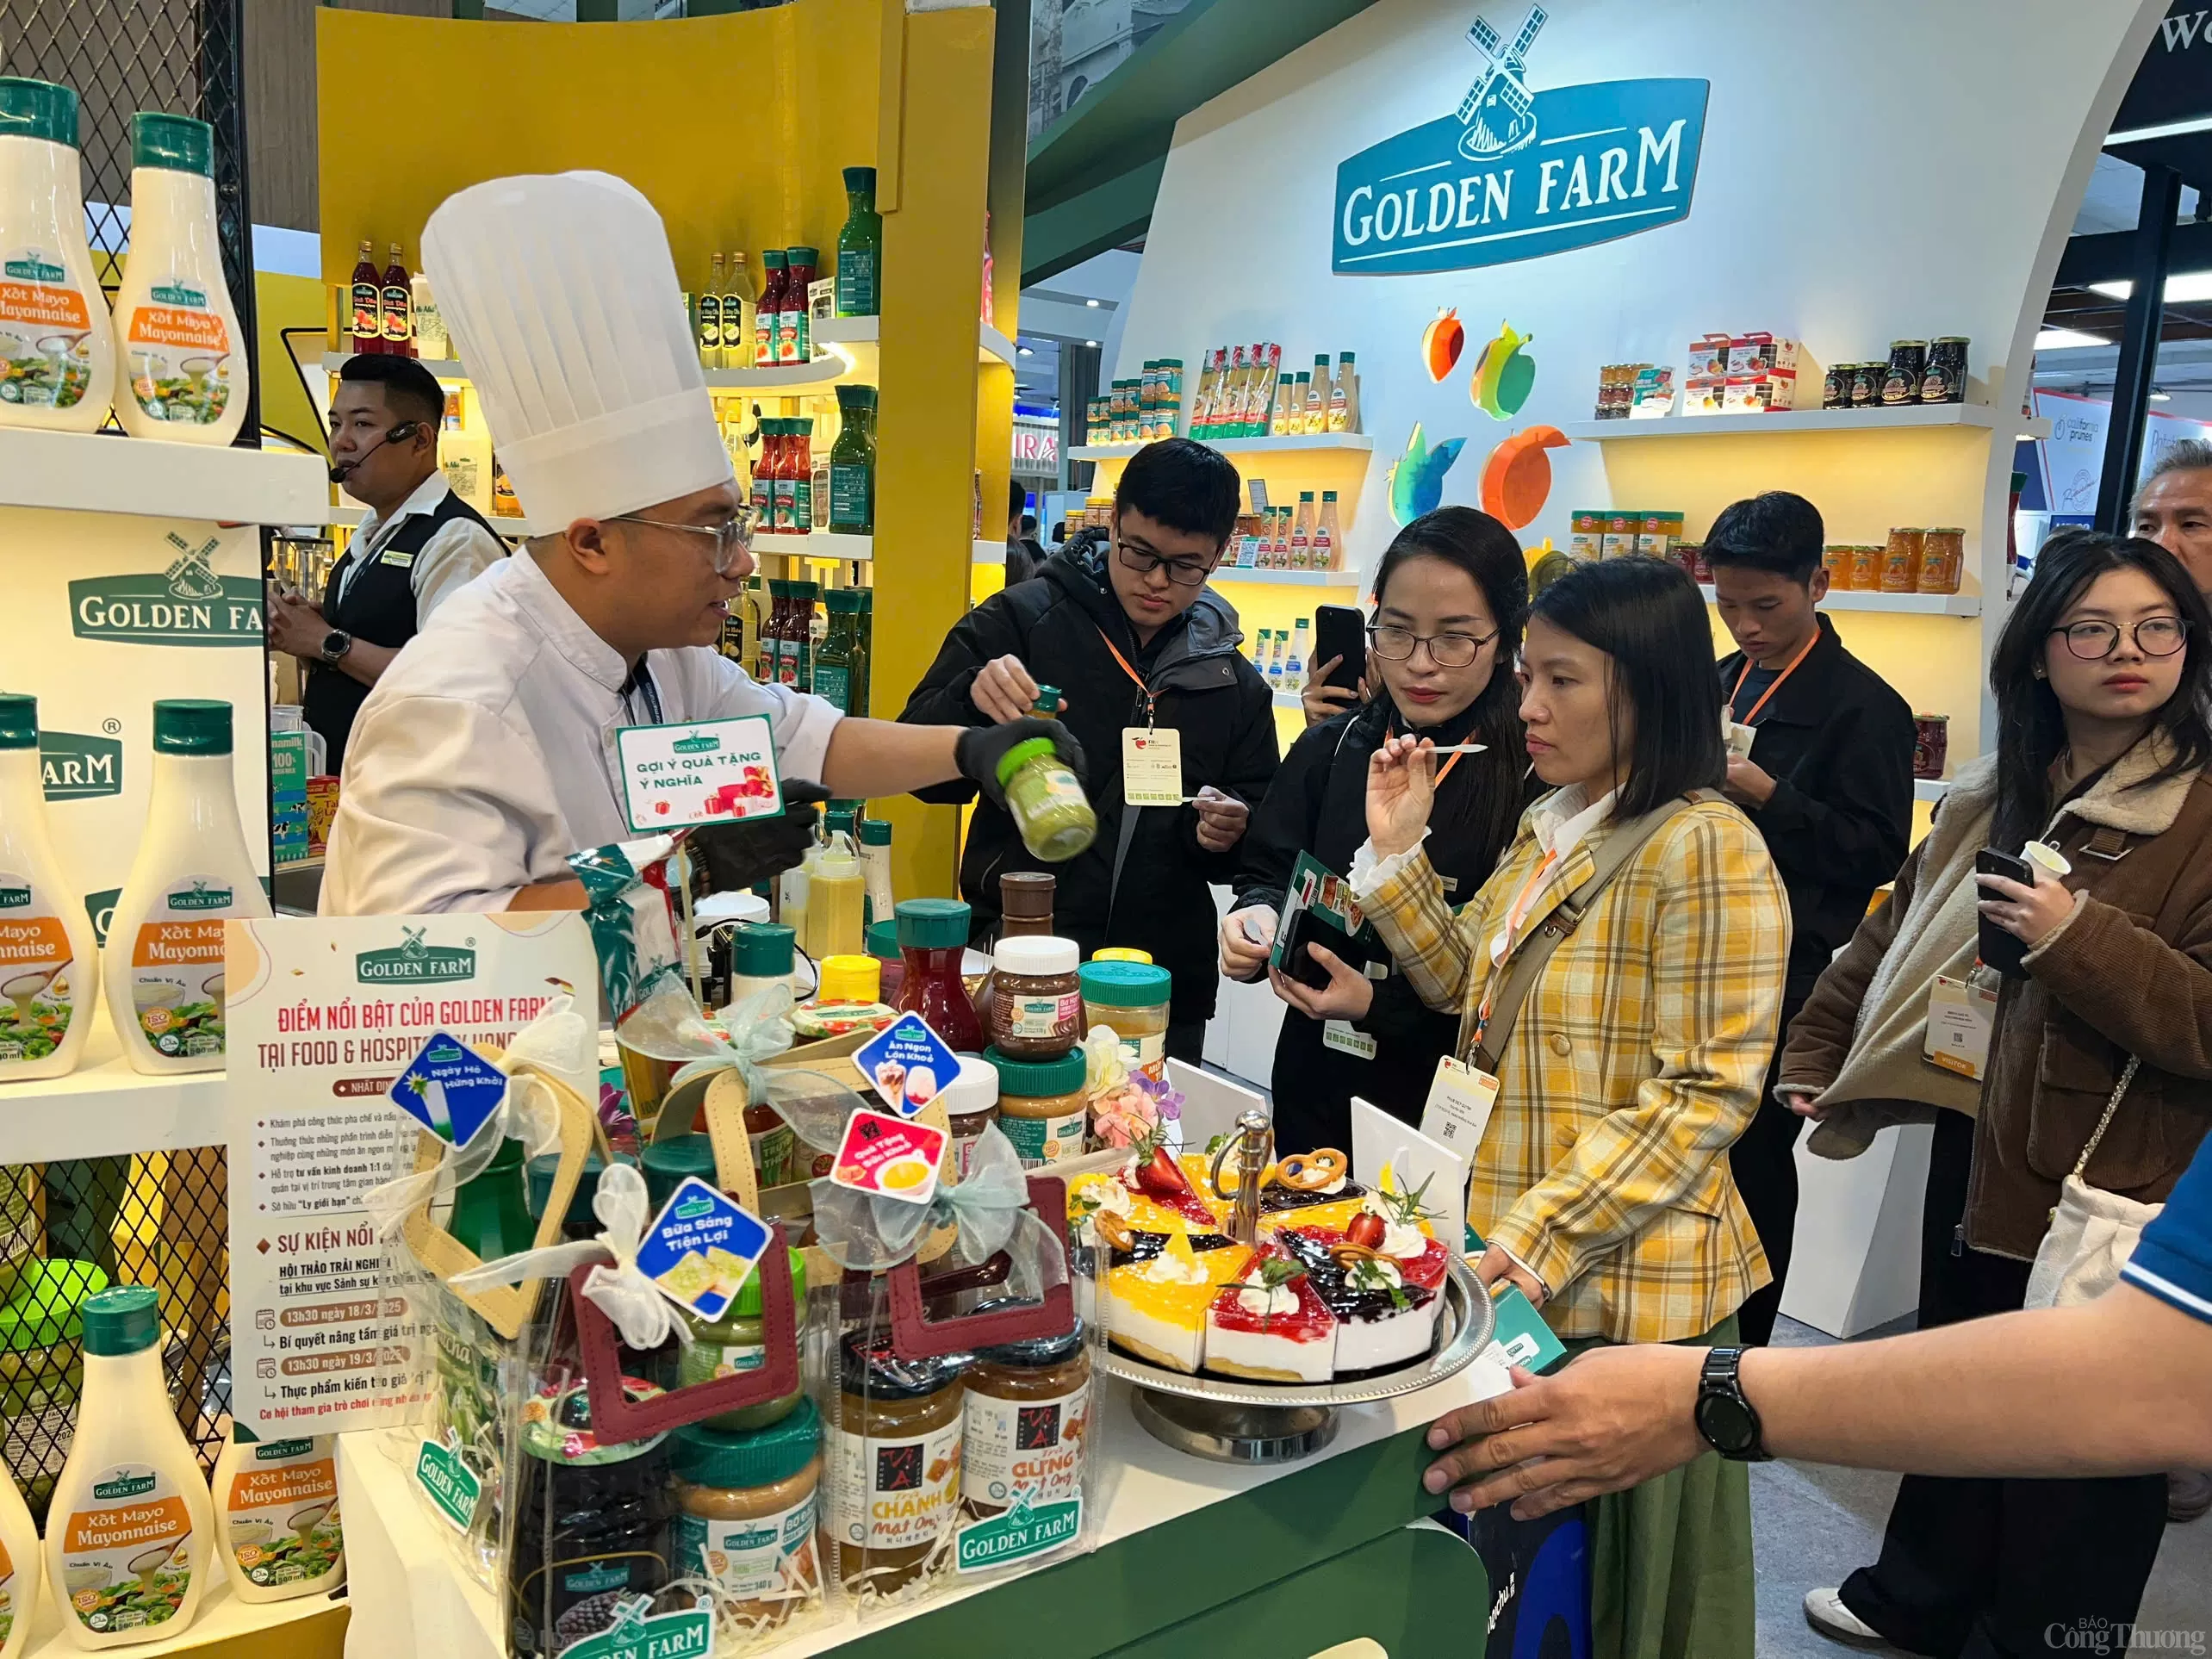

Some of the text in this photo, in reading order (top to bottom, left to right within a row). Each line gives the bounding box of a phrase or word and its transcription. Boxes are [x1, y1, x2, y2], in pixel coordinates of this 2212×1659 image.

[1343, 119, 1687, 246] GOLDEN FARM
[33, 290, 70, 308] Mayo
[139, 321, 221, 346] Mayonnaise
[79, 596, 212, 629] GOLDEN
[637, 761, 663, 774] GỢI
[682, 757, 714, 769] QUÀ
[718, 752, 761, 767] TẶNG
[655, 774, 703, 788] NGHĨA
[360, 957, 472, 977] GOLDEN FARM
[278, 998, 320, 1033] ĐIỂM
[327, 996, 356, 1030] NỔI
[363, 999, 395, 1033] BẬT
[401, 996, 434, 1027] CỦA
[440, 999, 503, 1024] GOLDEN
[258, 1040, 354, 1072] TẠI FOOD &
[904, 1041, 931, 1053] Ngon
[431, 1066, 462, 1078] Ngày
[345, 1115, 357, 1125] pha
[374, 1113, 382, 1122] và
[308, 1165, 321, 1177] vấn
[324, 1165, 341, 1174] kinh
[344, 1163, 368, 1173] doanh
[370, 1162, 381, 1171] 1:1
[277, 1221, 374, 1256] SỰ KIỆN NỔI
[662, 1215, 733, 1240] Bữa Sáng
[666, 1236, 702, 1252] Tiện
[279, 1257, 352, 1277] HỘI THẢO TRẢI
[279, 1283, 293, 1296] tại
[295, 1281, 313, 1293] khu
[315, 1280, 332, 1293] vực
[334, 1277, 357, 1289] Sảnh
[359, 1277, 370, 1289] sự
[287, 1307, 345, 1324] 13h30 ngày
[279, 1333, 291, 1349] Bí
[295, 1331, 326, 1350] quyết
[329, 1330, 356, 1345] nâng
[383, 1326, 398, 1342] giá
[288, 1355, 346, 1372] 13h30 ngày
[280, 1383, 308, 1401] Thực
[311, 1378, 340, 1397] phẩm
[345, 1374, 368, 1391] kiến
[259, 1397, 370, 1420] Cơ hội tham gia trò chơi
[283, 1466, 321, 1482] Mayo
[420, 1453, 455, 1496] GOLDEN
[96, 1479, 154, 1497] GOLDEN FARM
[240, 1479, 333, 1505] Mayonnaise
[122, 1507, 164, 1524] Mayo
[872, 1490, 941, 1519] CHANH
[78, 1519, 177, 1547] Mayonnaise
[961, 1509, 1076, 1560] GOLDEN FARM
